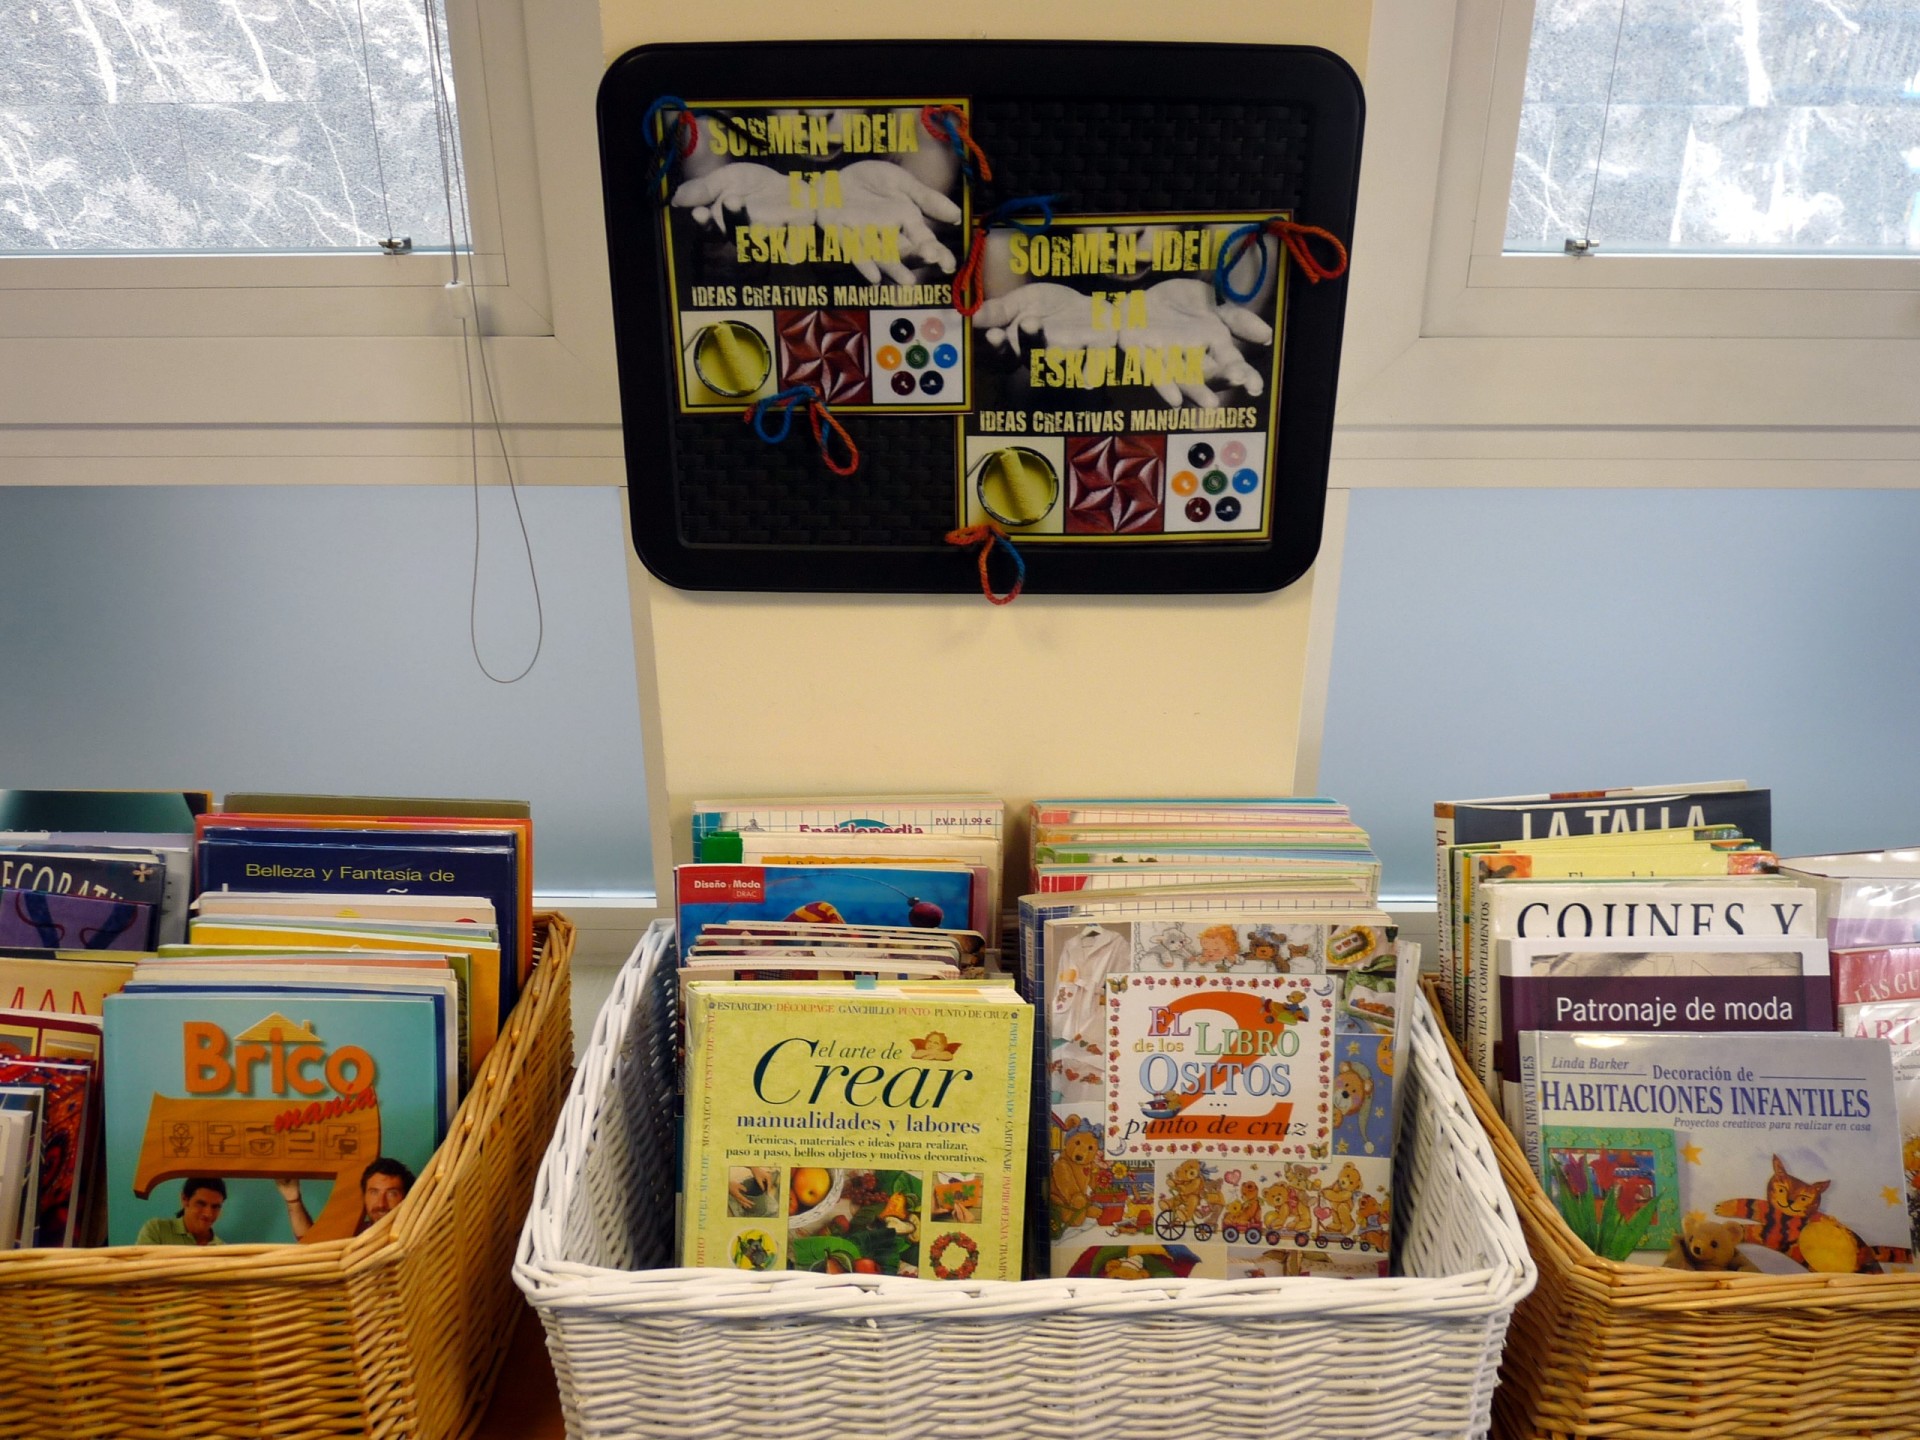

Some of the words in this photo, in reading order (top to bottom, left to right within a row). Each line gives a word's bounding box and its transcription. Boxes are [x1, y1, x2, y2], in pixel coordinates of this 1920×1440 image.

[789, 170, 843, 209] ETA
[692, 286, 737, 307] IDEAS
[742, 285, 828, 307] CREATIVAS
[833, 284, 953, 307] MANUALIDADES
[1091, 290, 1147, 330] ETA
[980, 411, 1027, 432] IDEAS
[1032, 409, 1124, 433] CREATIVAS
[1130, 407, 1257, 431] MANUALIDADES
[959, 817, 982, 825] 11.99
[246, 863, 315, 879] Belleza
[322, 869, 333, 881] y
[340, 866, 422, 881] Fantasía
[429, 868, 455, 882] de
[694, 880, 727, 889] Diseño
[733, 880, 761, 889] Moda
[736, 890, 757, 898] DRAC
[1771, 903, 1803, 936] Y
[1479, 902, 1489, 993] COMPLEMENTOS
[717, 1002, 772, 1012] ESTARCIDO
[838, 1005, 895, 1016] GANCHILLO
[898, 1007, 930, 1017] PUNTO
[934, 1008, 967, 1018] PUNTO
[968, 1010, 982, 1019] DE
[983, 1011, 1009, 1020] CRUZ
[1479, 1006, 1487, 1035] TELAS
[1557, 996, 1677, 1027] Patronaje
[1685, 996, 1716, 1021] de
[1725, 996, 1793, 1021] moda
[818, 1040, 836, 1058] el
[839, 1044, 876, 1060] arte
[881, 1042, 902, 1060] de
[1132, 1039, 1153, 1053] de
[1159, 1038, 1185, 1053] los
[1195, 1022, 1300, 1057] LIBRO
[183, 1021, 376, 1095] Brico
[1551, 1056, 1585, 1070] Linda
[1589, 1057, 1629, 1070] Barker
[753, 1037, 974, 1109] Crear
[1139, 1053, 1292, 1097] OSITOS
[1653, 1065, 1732, 1081] Decoración
[1737, 1067, 1754, 1082] de
[1522, 1055, 1537, 1125] INFANTILES
[1541, 1080, 1723, 1115] HABITACIONES
[1730, 1086, 1871, 1118] INFANTILES
[702, 1096, 710, 1147] MOSAICO
[737, 1111, 881, 1131] manualidades
[886, 1119, 896, 1137] y
[907, 1114, 980, 1134] labores
[1124, 1117, 1198, 1140] punto
[1207, 1114, 1238, 1135] de
[1247, 1122, 1308, 1136] cruz
[1673, 1117, 1720, 1129] Proyectos
[1722, 1118, 1766, 1129] creativos
[1769, 1121, 1791, 1131] para
[1795, 1120, 1833, 1131] realizar
[1835, 1123, 1847, 1131] en
[1850, 1123, 1871, 1131] casa
[726, 1148, 750, 1158] paso
[763, 1149, 791, 1159] paso,
[794, 1147, 825, 1158] bellos
[828, 1149, 867, 1160] objetos
[869, 1152, 876, 1161] y
[880, 1150, 921, 1160] motivos
[924, 1151, 987, 1162] decorativos.
[747, 1134, 797, 1146] Técnicas,
[800, 1137, 855, 1147] materiales
[868, 1137, 895, 1148] ideas
[898, 1141, 922, 1151] para
[926, 1140, 969, 1151] realizar,
